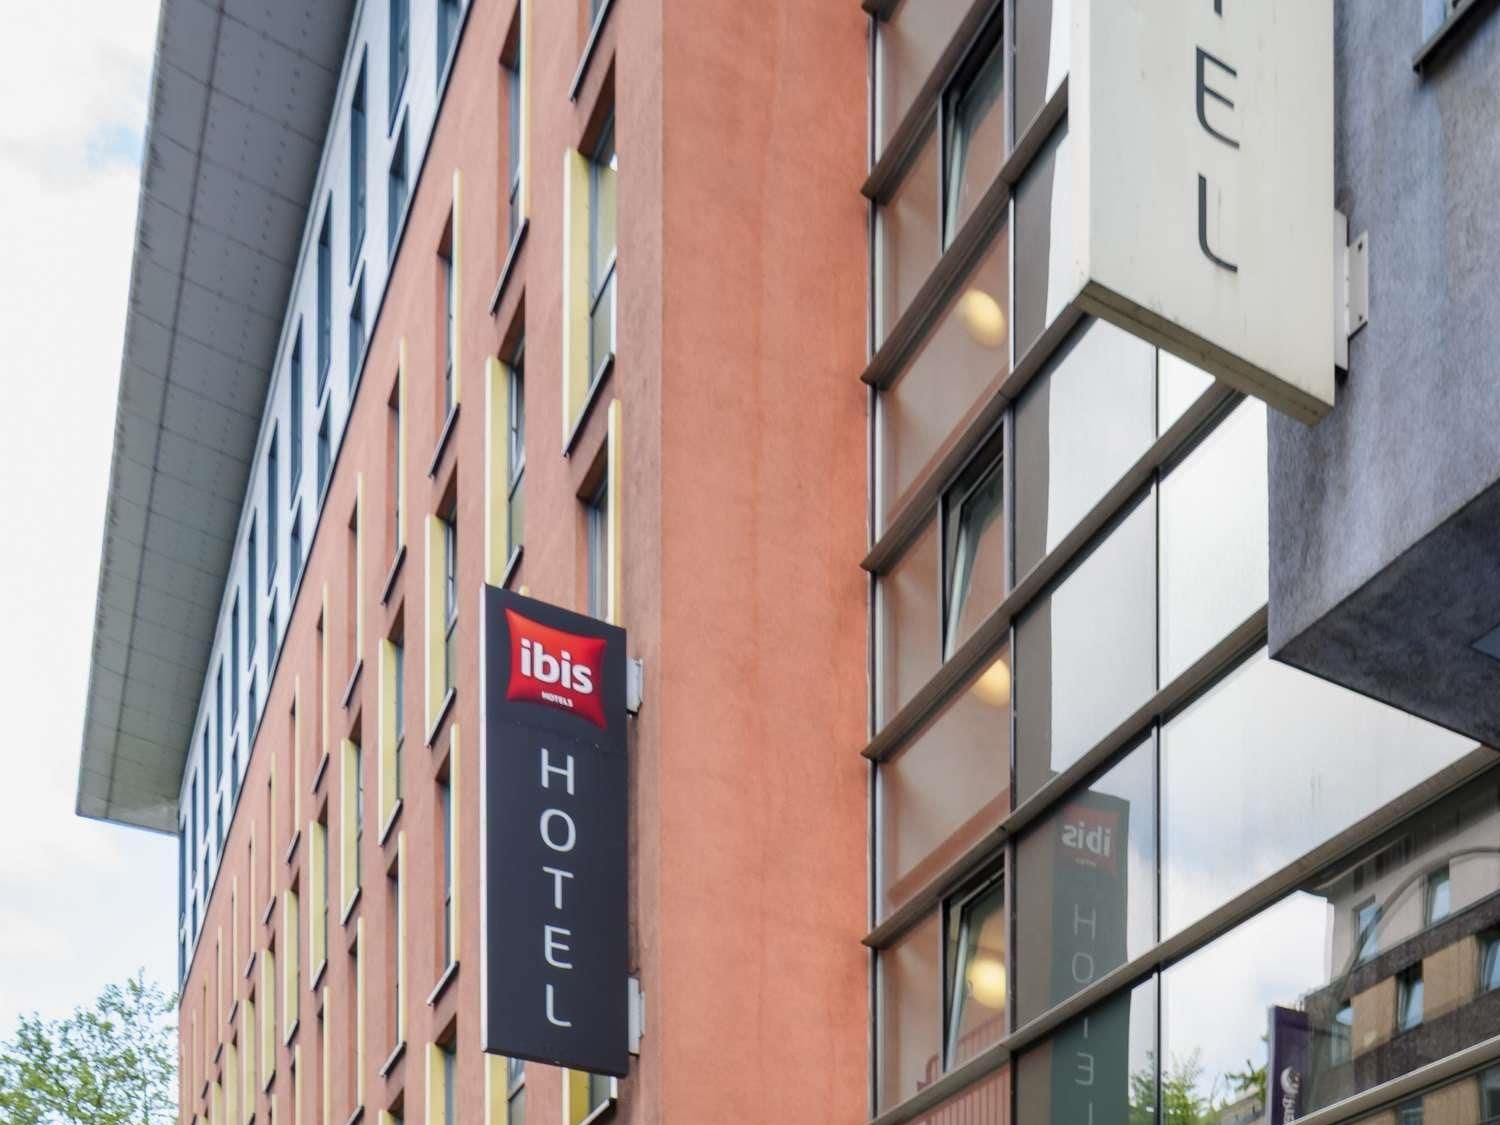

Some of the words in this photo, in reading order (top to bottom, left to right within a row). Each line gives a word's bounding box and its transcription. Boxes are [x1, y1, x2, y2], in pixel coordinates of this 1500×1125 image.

[1196, 0, 1240, 274] EL
[520, 636, 594, 695] ibis
[539, 748, 577, 1028] HOTEL
